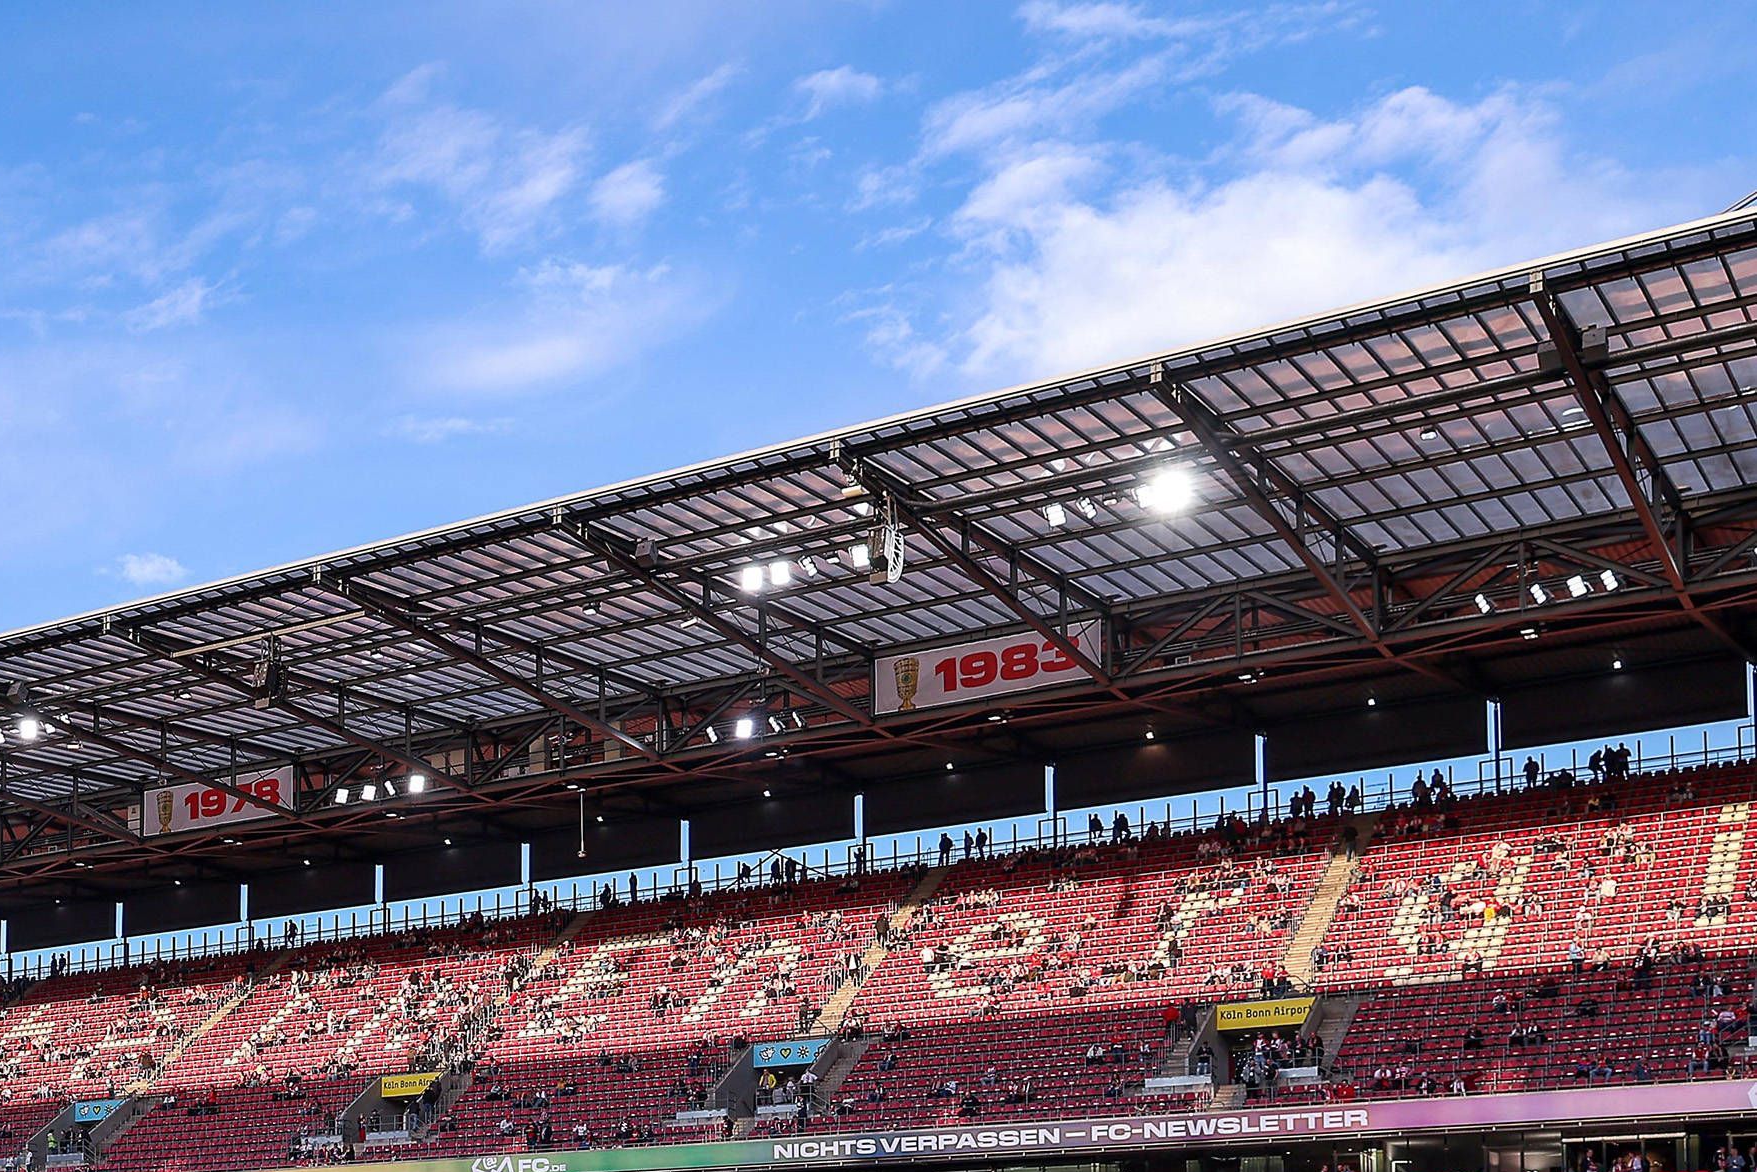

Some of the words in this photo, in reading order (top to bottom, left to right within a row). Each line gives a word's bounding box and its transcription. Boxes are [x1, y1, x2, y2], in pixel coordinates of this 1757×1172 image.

[935, 636, 1079, 692] 1983
[1220, 1010, 1242, 1019] Köln
[1246, 1008, 1271, 1018] Bonn
[400, 1080, 417, 1088] Bonn
[773, 1139, 877, 1159] NICHTS
[879, 1128, 1060, 1153] VERPASSEN
[1093, 1109, 1369, 1142] FC-NEWSLETTER
